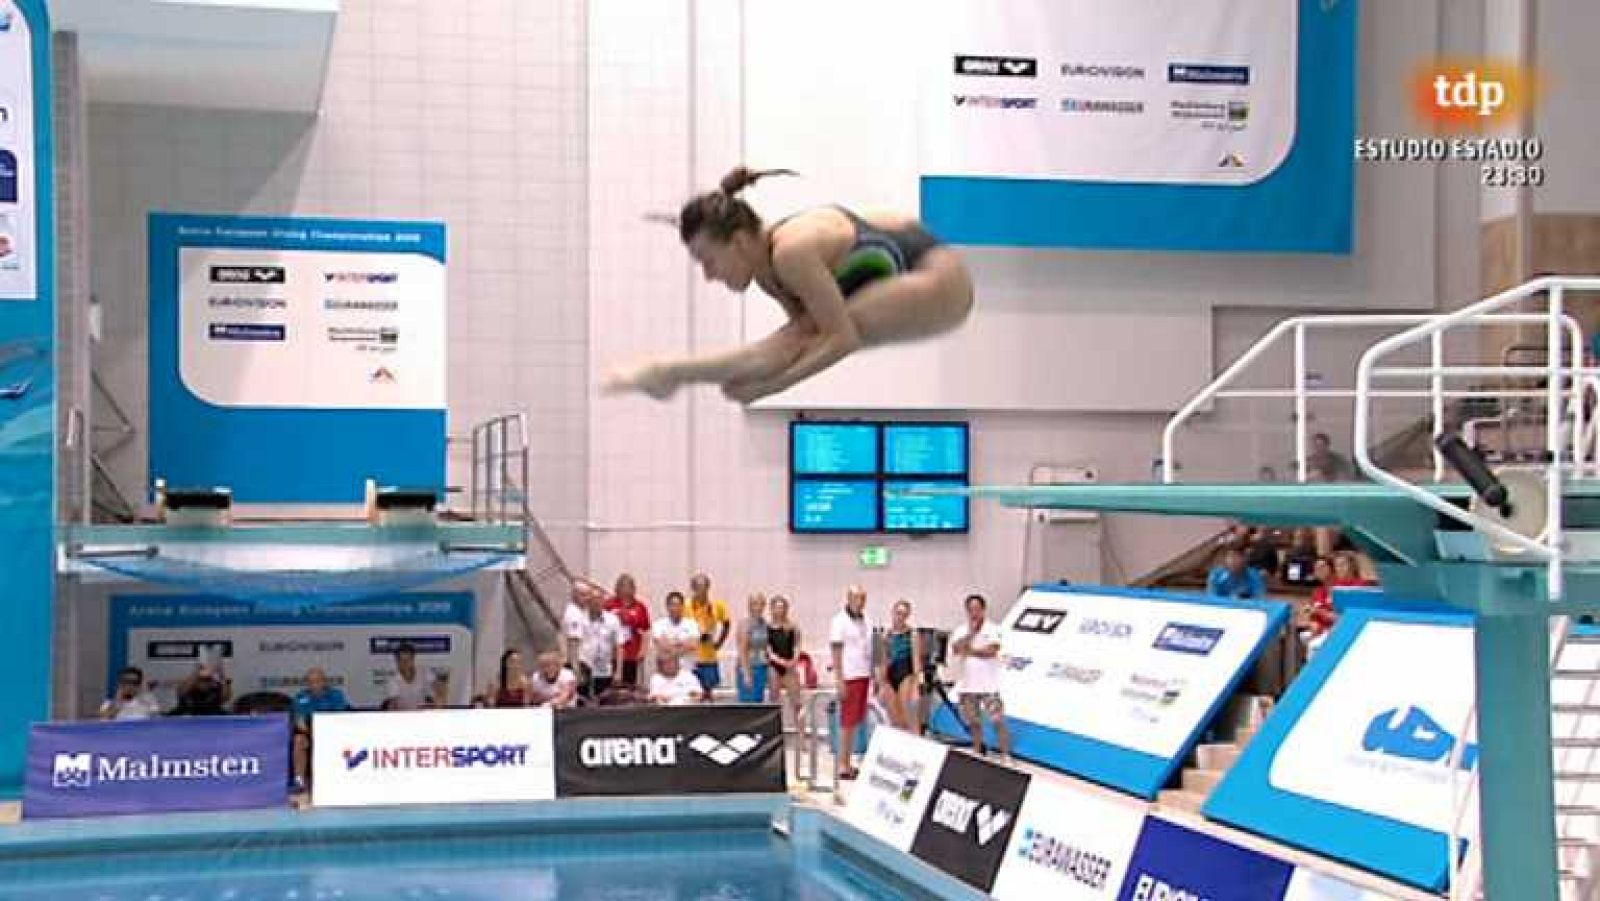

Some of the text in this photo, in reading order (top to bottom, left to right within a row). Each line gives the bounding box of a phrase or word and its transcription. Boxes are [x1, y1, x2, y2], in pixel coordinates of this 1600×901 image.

[372, 744, 530, 769] INTERSPORT
[579, 735, 678, 768] arena
[98, 754, 261, 782] Malmsten
